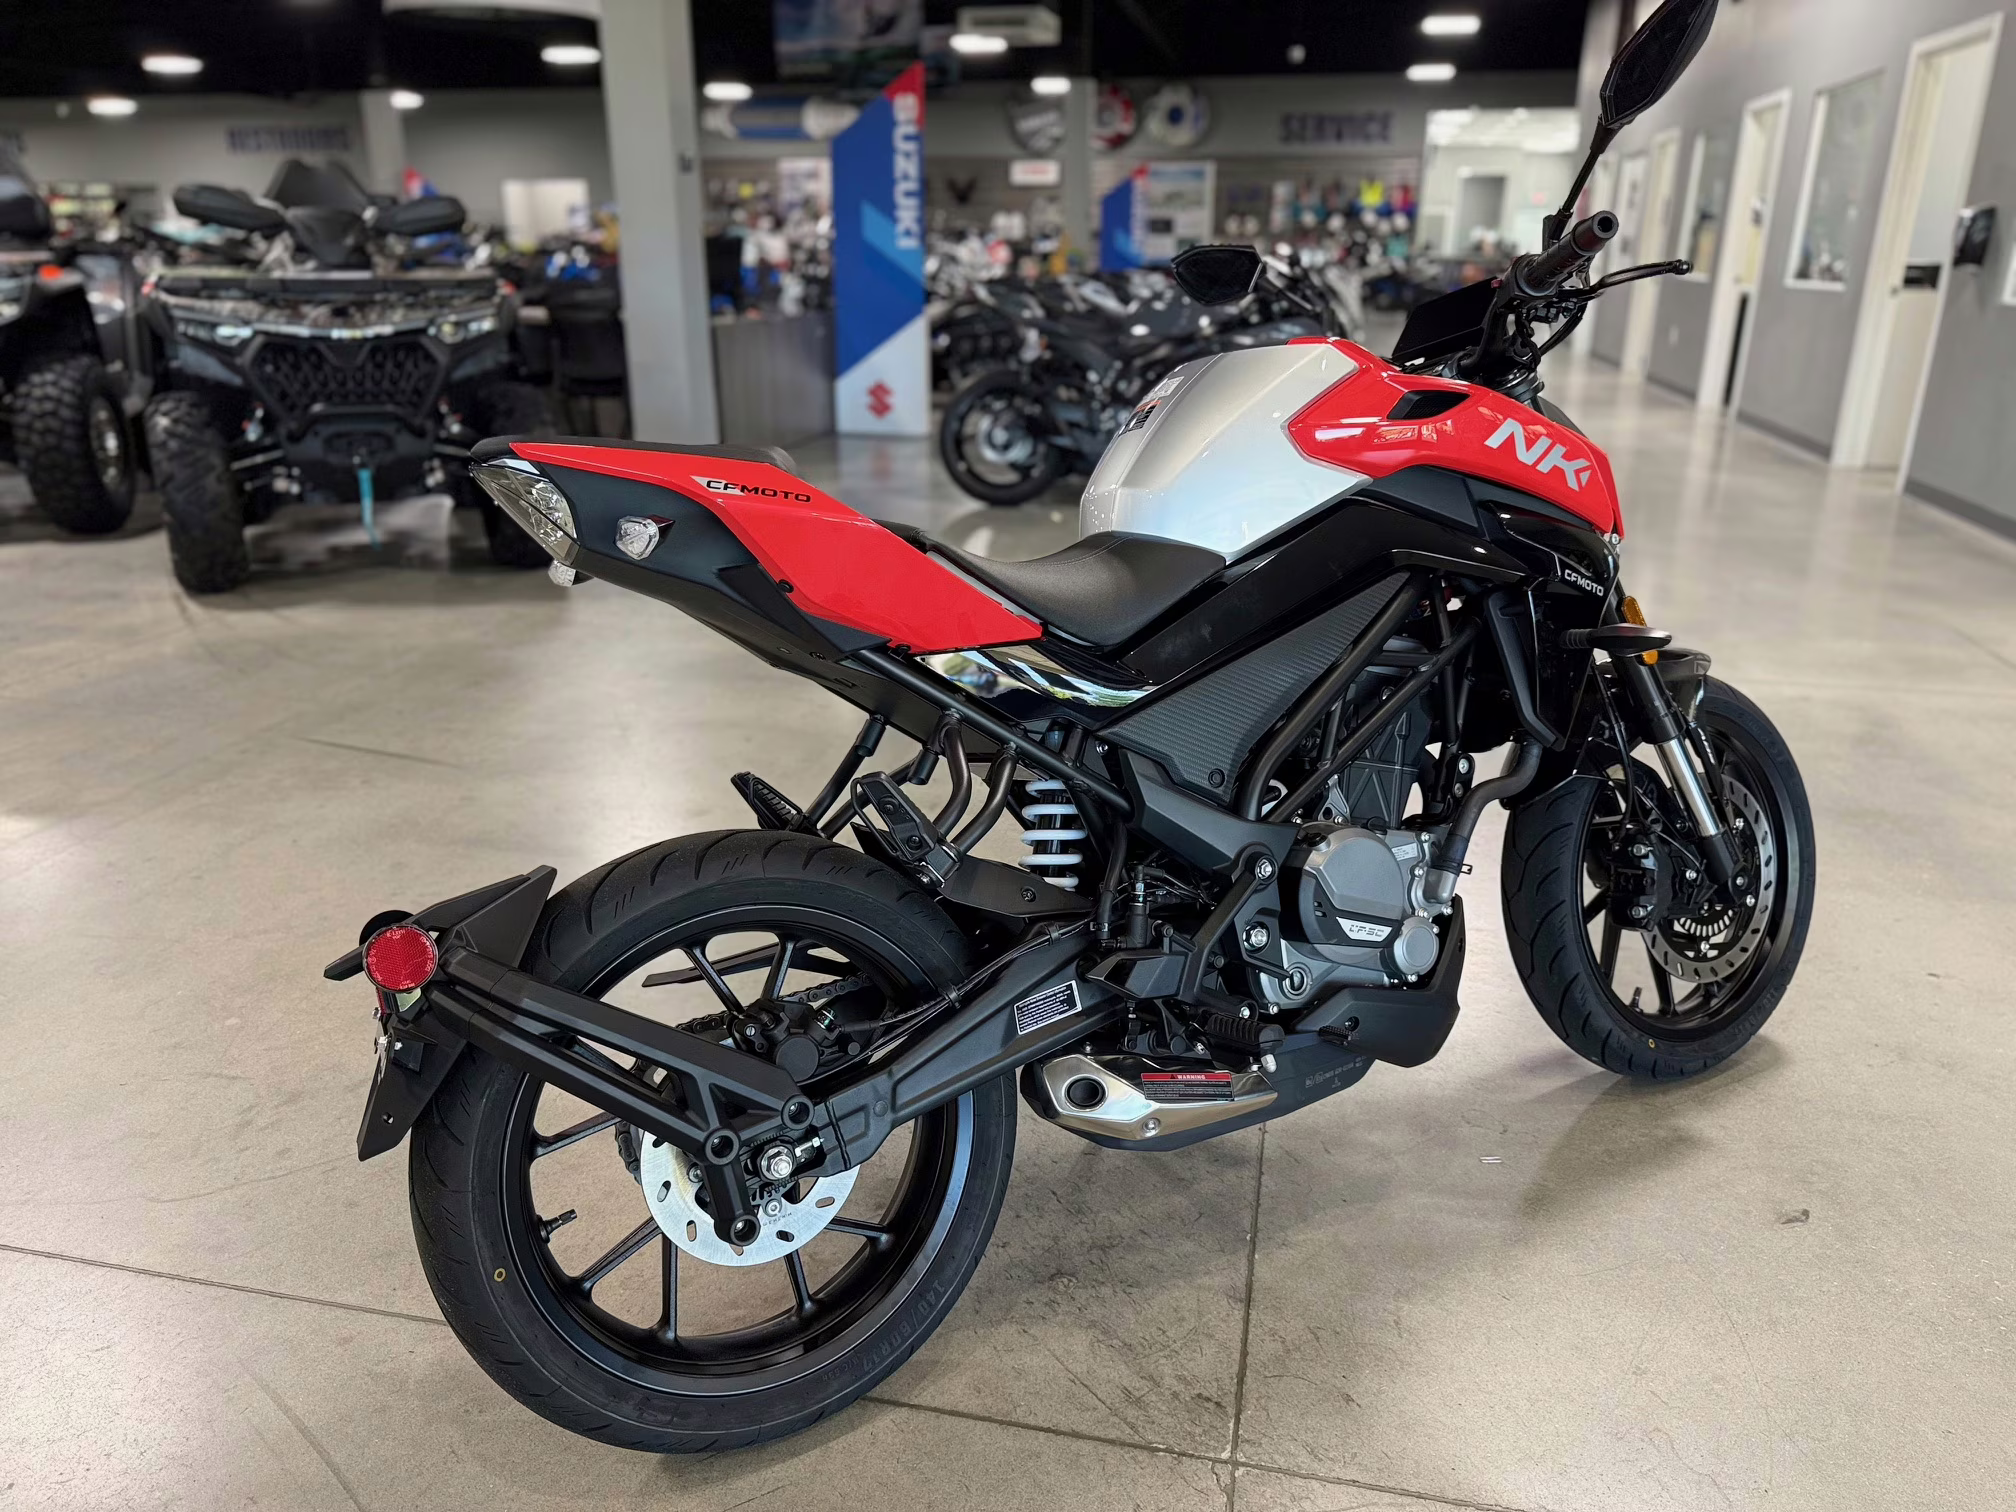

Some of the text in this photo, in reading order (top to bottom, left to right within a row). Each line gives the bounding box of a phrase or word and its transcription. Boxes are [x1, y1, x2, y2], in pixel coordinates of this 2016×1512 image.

[893, 92, 920, 249] SUZUKI
[1484, 418, 1591, 492] NK
[706, 480, 811, 503] CFMOTO
[1564, 569, 1604, 597] CFMOTO
